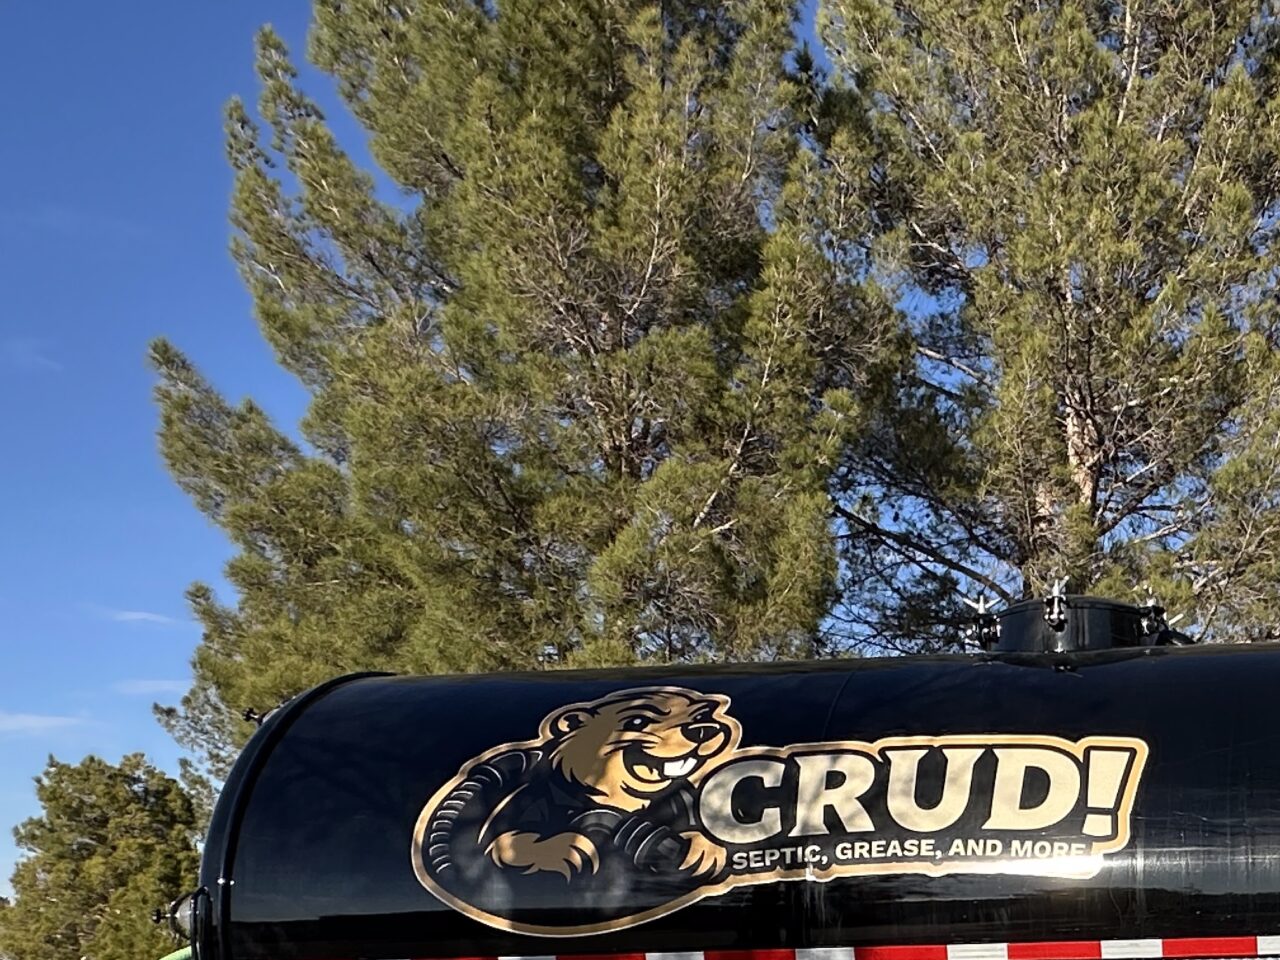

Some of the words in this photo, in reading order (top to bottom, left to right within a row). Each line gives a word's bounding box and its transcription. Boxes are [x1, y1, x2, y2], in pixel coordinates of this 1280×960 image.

[700, 748, 1133, 844] CRUD!
[732, 844, 829, 870] SEPTIC,
[835, 838, 942, 860] GREASE,
[948, 838, 1003, 857] AND
[1010, 840, 1086, 858] MORE
